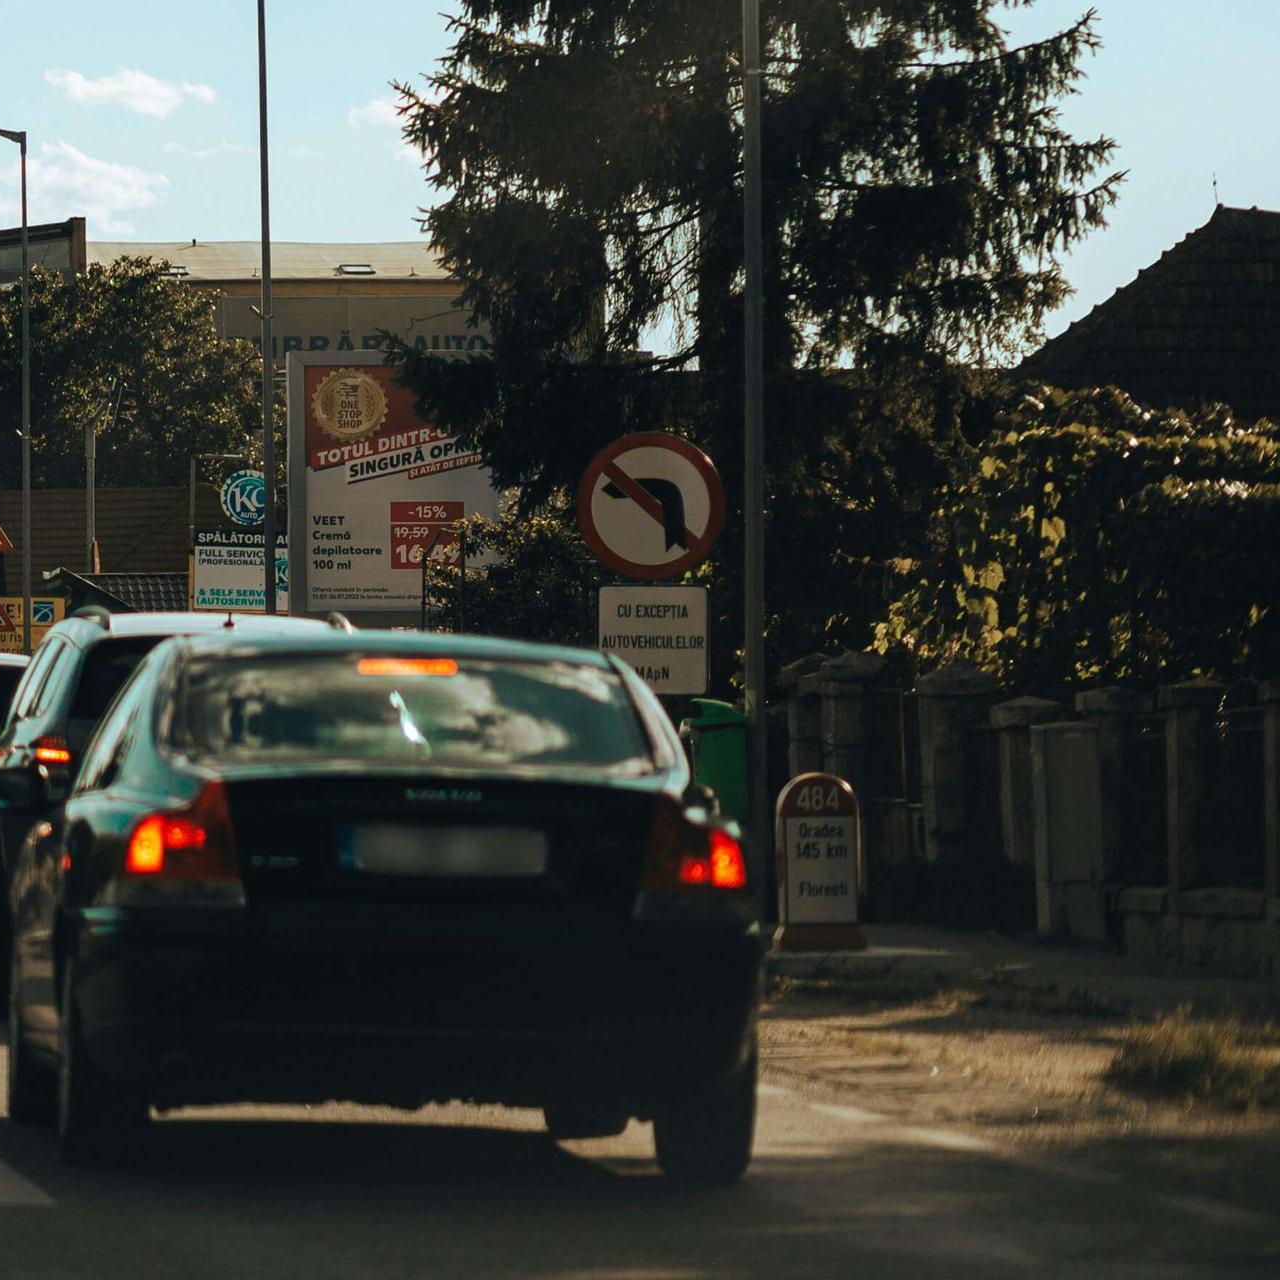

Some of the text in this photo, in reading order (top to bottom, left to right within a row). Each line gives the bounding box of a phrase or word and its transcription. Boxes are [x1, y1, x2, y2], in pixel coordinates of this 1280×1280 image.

[340, 400, 360, 410] ONE
[338, 410, 362, 420] STOP
[337, 420, 363, 430] SHOP
[317, 445, 374, 466] TOTUL
[349, 445, 425, 478] SINGURĂ
[443, 461, 454, 470] DE
[408, 505, 447, 519] -15%
[312, 516, 345, 526] VEET
[198, 531, 266, 544] SPĂLĂTORI
[199, 549, 264, 559] FULL SERVIC
[312, 545, 383, 557] depilatoare
[312, 560, 352, 570] 100 ml
[209, 588, 235, 597] SELF
[196, 596, 265, 606] (AUTOSERVIR
[617, 604, 632, 618] CU
[9, 631, 23, 643] ris
[601, 635, 705, 649] AUTOVEHICULELOR
[635, 666, 670, 682] MApN
[795, 785, 840, 812] 484
[799, 822, 844, 838] Oradea
[795, 841, 847, 858] 145 km
